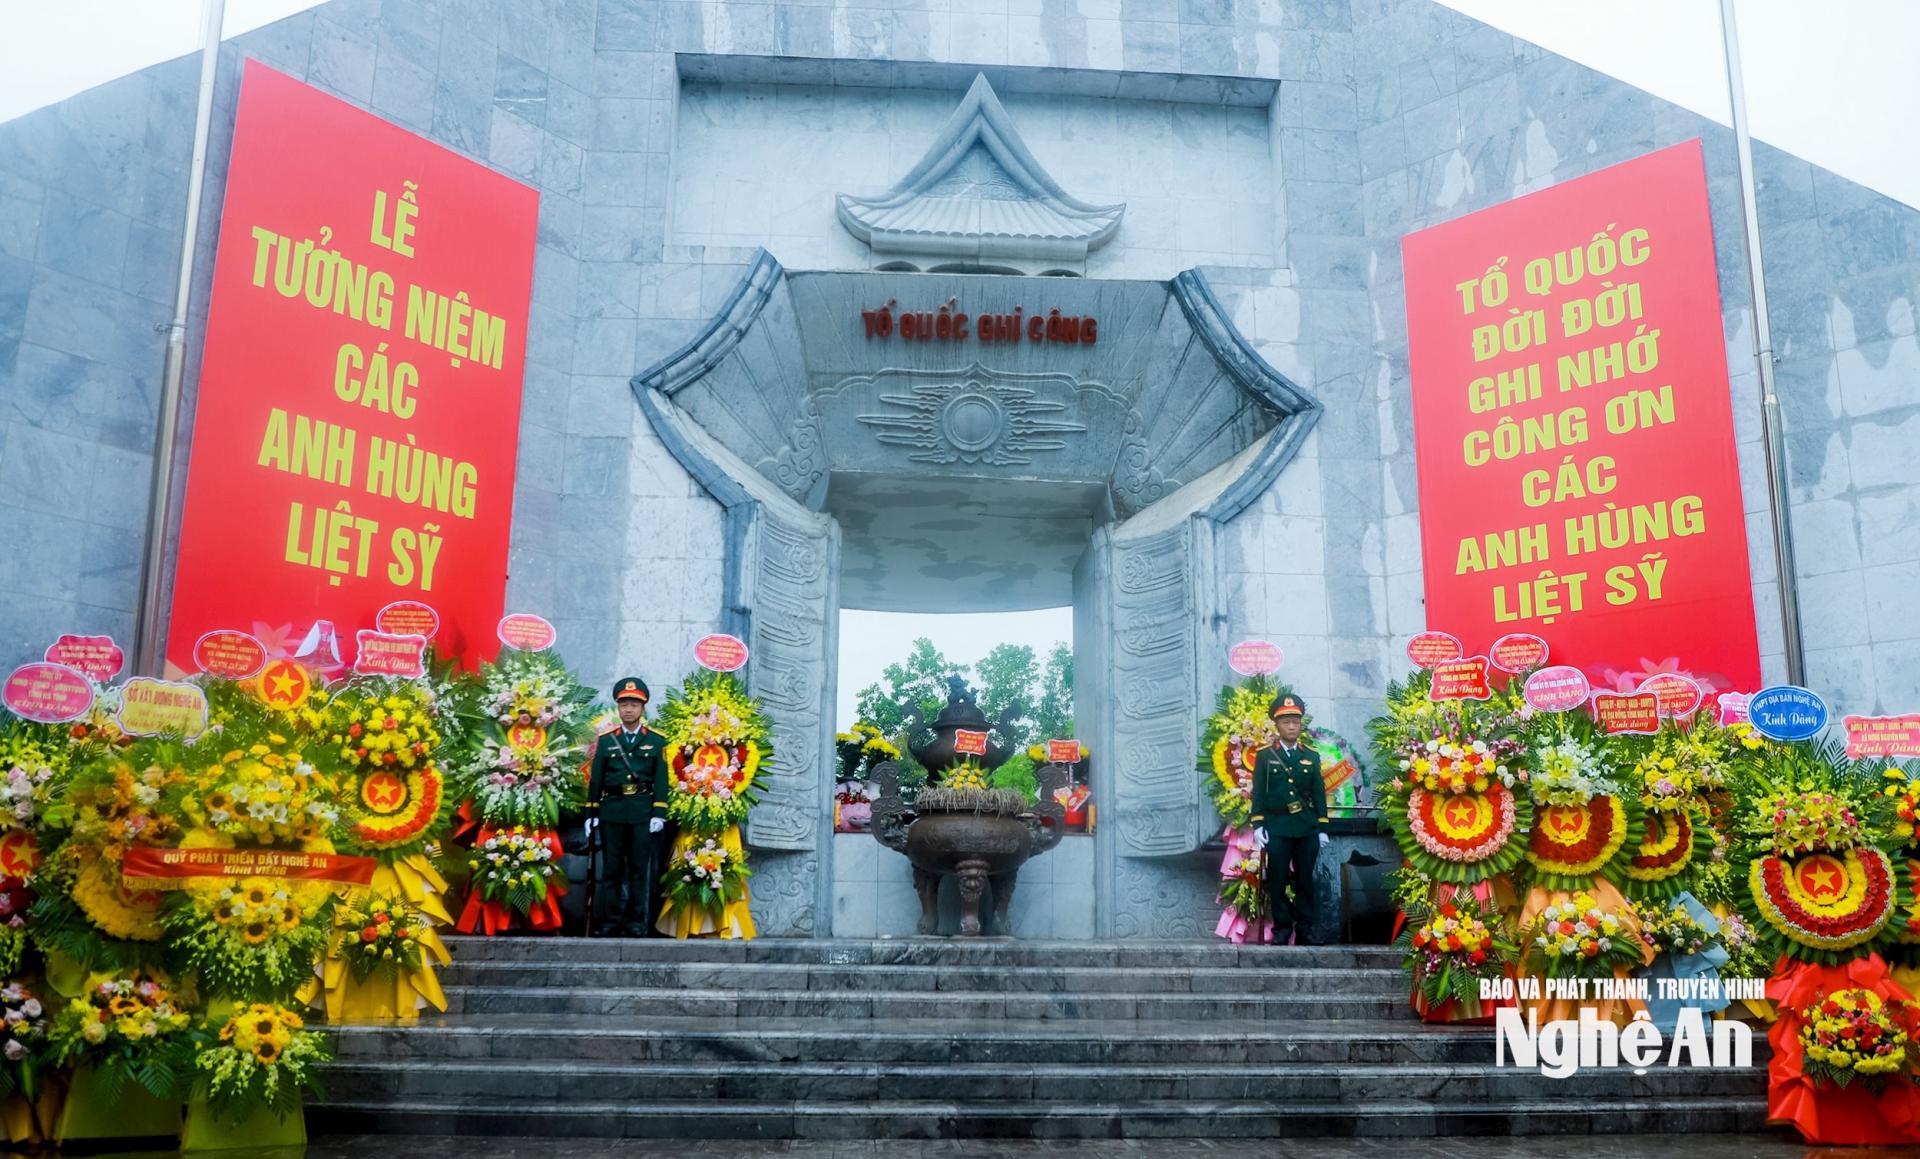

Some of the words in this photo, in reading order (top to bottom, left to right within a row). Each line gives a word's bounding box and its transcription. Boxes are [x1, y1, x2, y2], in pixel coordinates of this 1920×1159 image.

[370, 180, 419, 258] LỄ
[251, 225, 394, 330] TƯỞNG
[405, 284, 506, 370] NIỆM
[1456, 256, 1509, 315] TỔ
[1524, 222, 1650, 296] QUỐC
[900, 296, 969, 339] QUỐC
[1028, 306, 1097, 344] CÔNG
[1472, 307, 1546, 362] ĐỜI
[1561, 281, 1643, 337] ĐỜI
[334, 343, 419, 419] CÁC
[1468, 363, 1541, 414] GHI
[1557, 325, 1661, 393] NHỚ
[257, 407, 356, 487] ANH
[366, 433, 478, 519] HÙNG
[1463, 407, 1589, 467] CÔNG
[1605, 385, 1676, 435] ƠN
[1522, 455, 1617, 507] CÁC
[284, 499, 378, 586] LIỆT
[387, 524, 443, 591] SỸ
[1455, 523, 1549, 575] ANH
[1564, 495, 1705, 556] HÙNG
[1493, 571, 1587, 624] LIỆT
[1605, 552, 1668, 605] SỸ
[1761, 712, 1787, 726] Kính
[1789, 711, 1817, 727] Dâng
[1851, 742, 1882, 753] Kính
[163, 850, 187, 864] QUỸ
[190, 851, 219, 864] PHÁT
[258, 851, 279, 865] ĐẤT
[281, 854, 309, 869] NGHỆ
[312, 857, 327, 868] AN
[223, 864, 251, 875] KÍNH
[255, 865, 287, 875] VIẾNG
